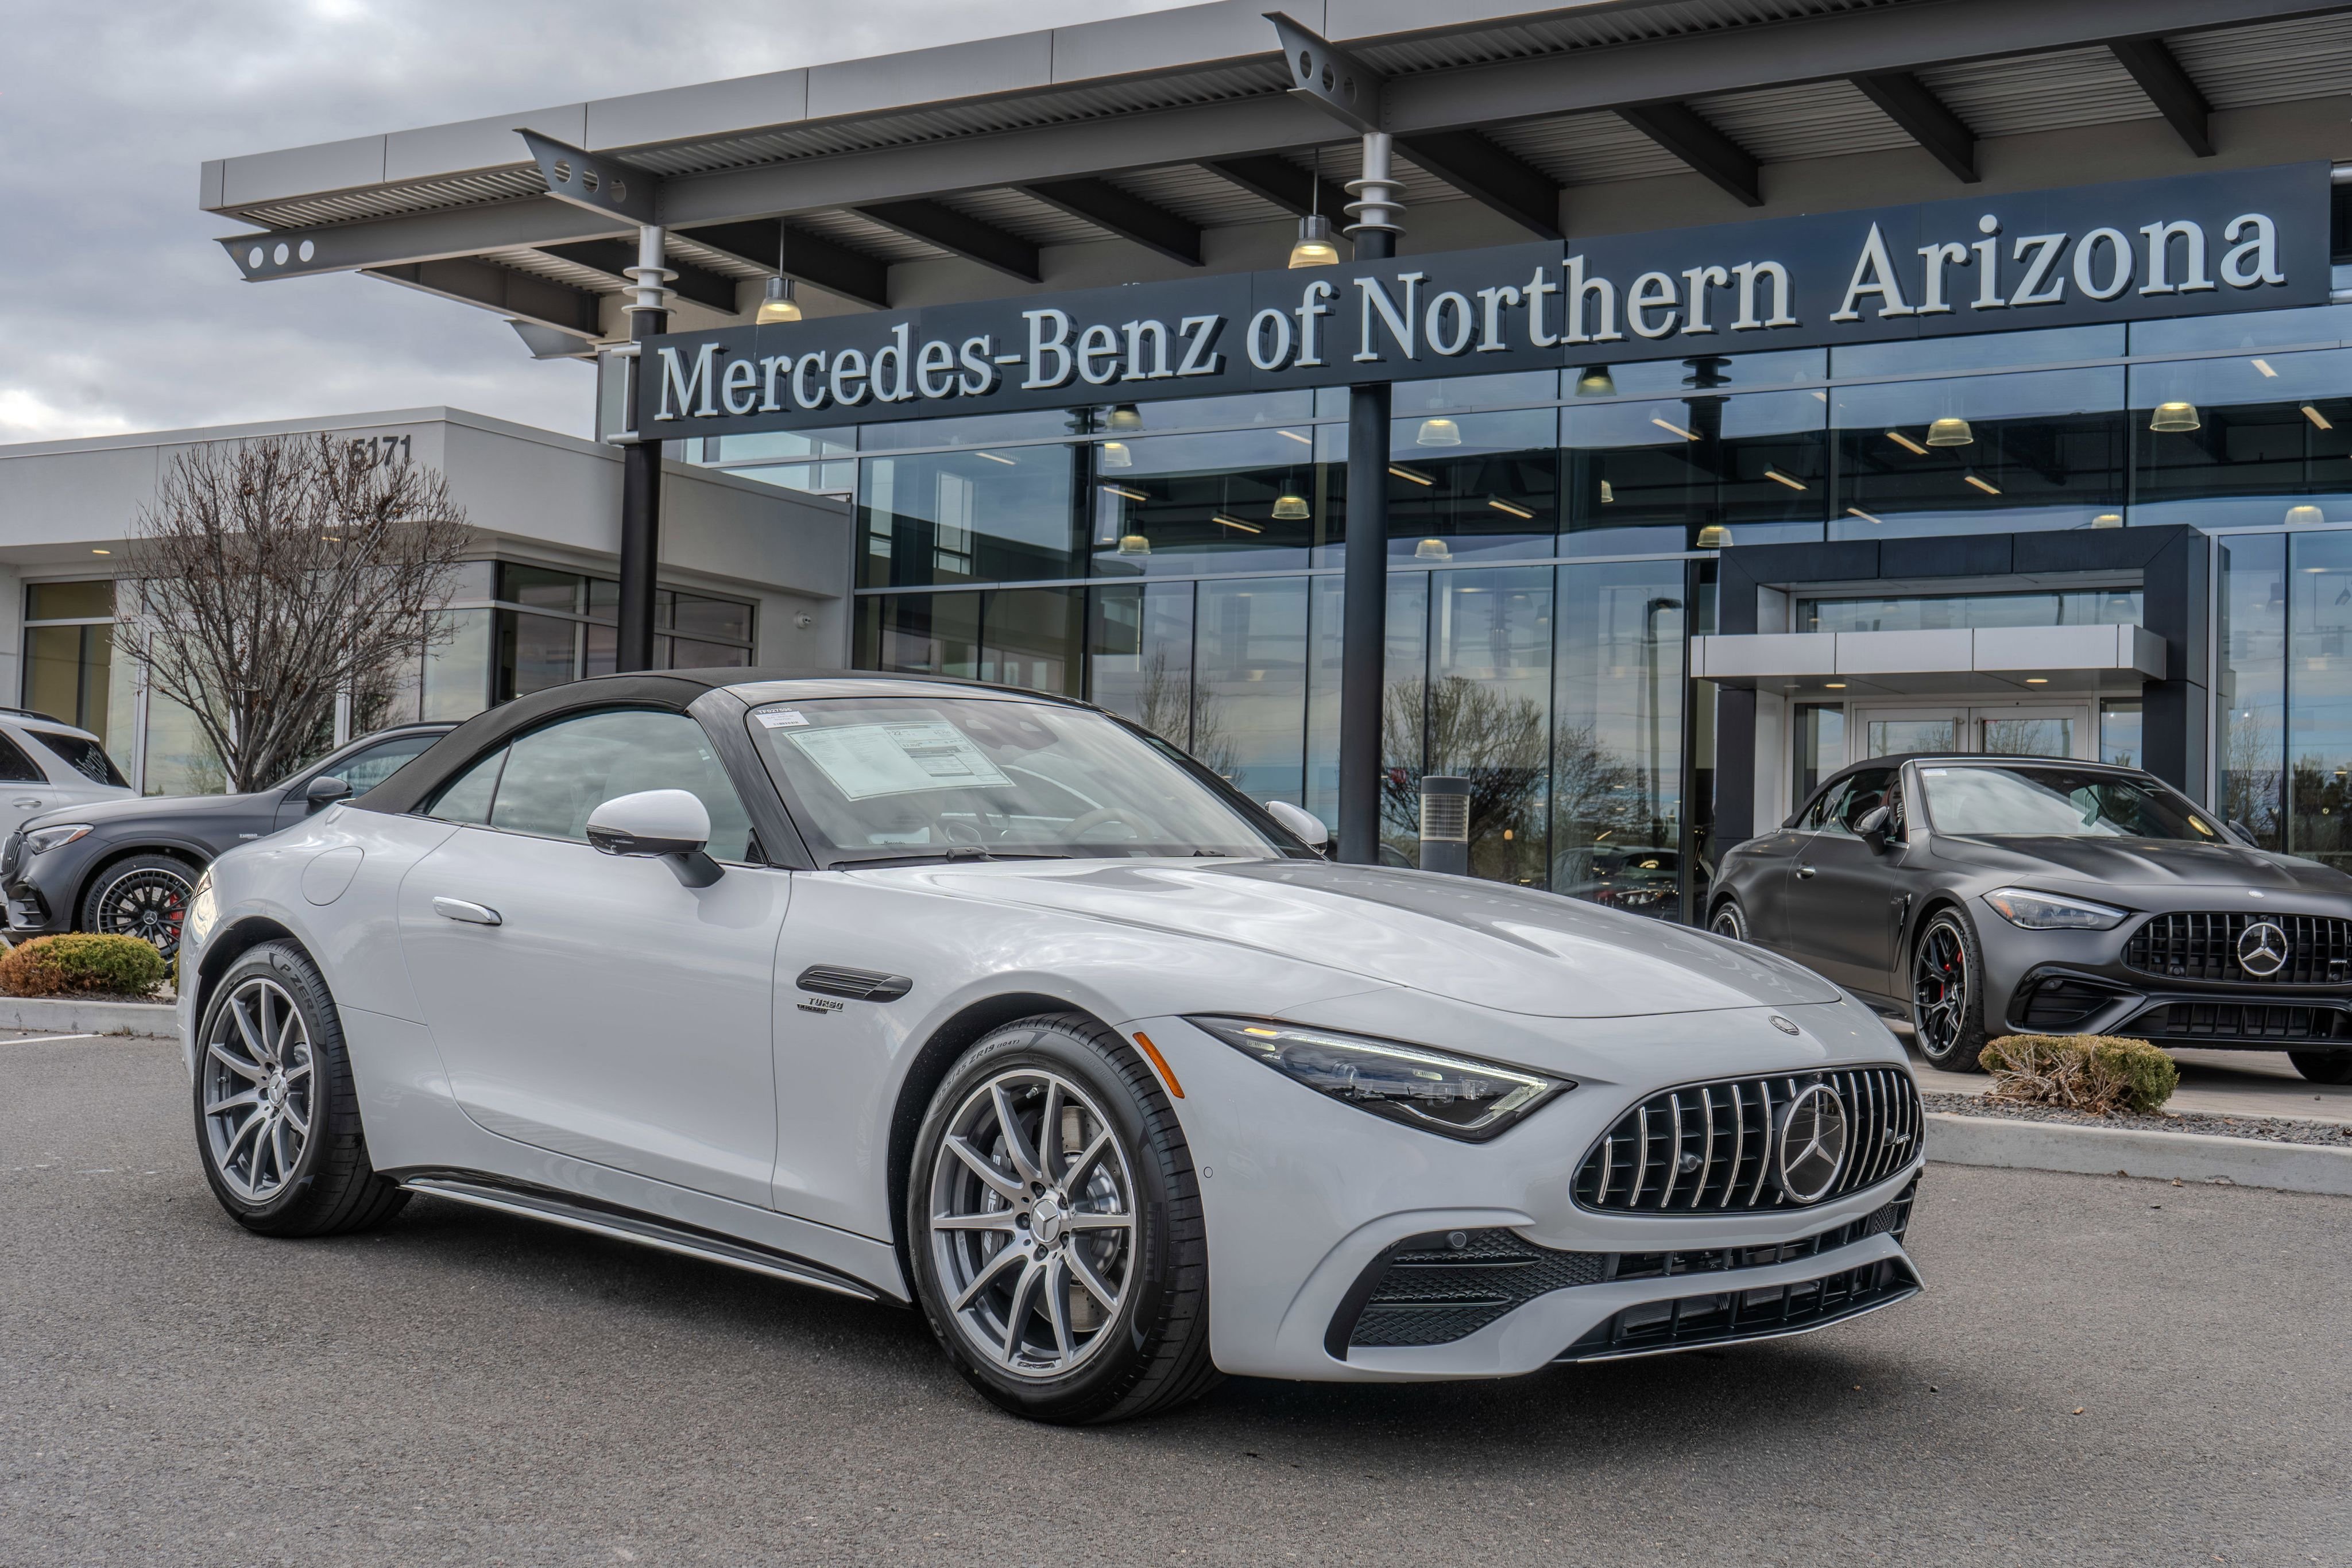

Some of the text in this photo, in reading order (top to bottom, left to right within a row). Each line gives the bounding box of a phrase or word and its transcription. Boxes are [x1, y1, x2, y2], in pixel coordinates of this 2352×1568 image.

[653, 212, 2286, 422] Mercedes-Benz of Northern Arizona
[352, 434, 411, 467] 5171
[808, 997, 844, 1010] TURBO
[936, 1062, 968, 1104] 255/45
[969, 1044, 996, 1065] ZR19
